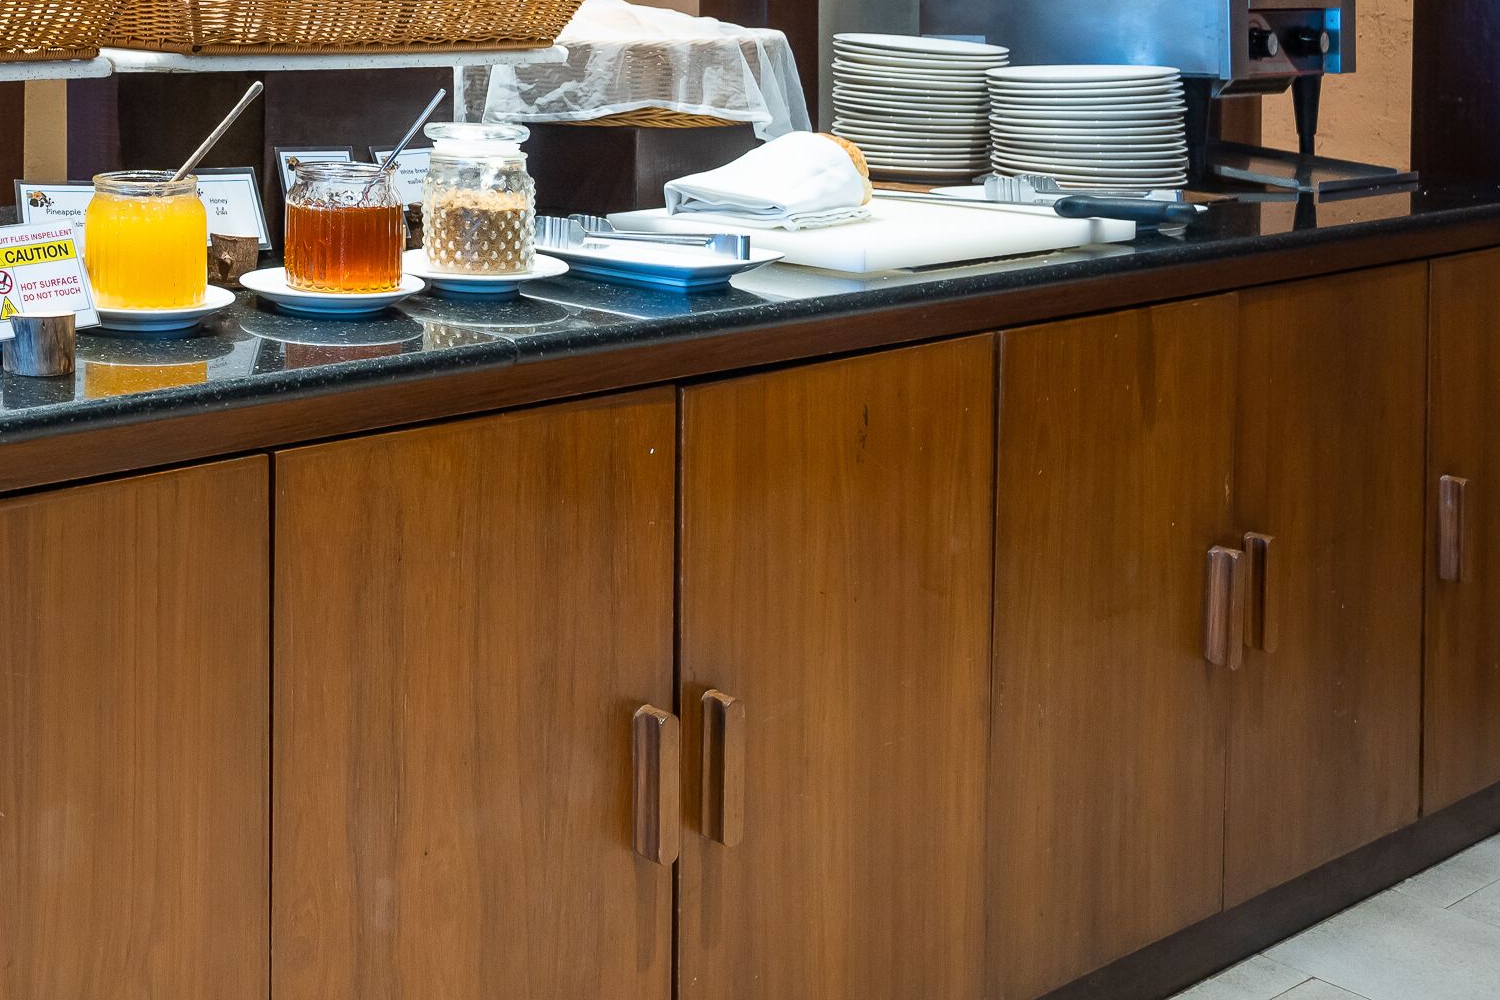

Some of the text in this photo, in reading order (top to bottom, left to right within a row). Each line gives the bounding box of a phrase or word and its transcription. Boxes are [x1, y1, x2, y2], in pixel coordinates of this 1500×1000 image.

[10, 234, 29, 244] FLIES
[30, 228, 72, 240] INSPELLENT
[4, 243, 69, 264] CAUTION
[20, 275, 79, 292] HOT SURFACE
[23, 287, 81, 302] DO NOT TOUCH
